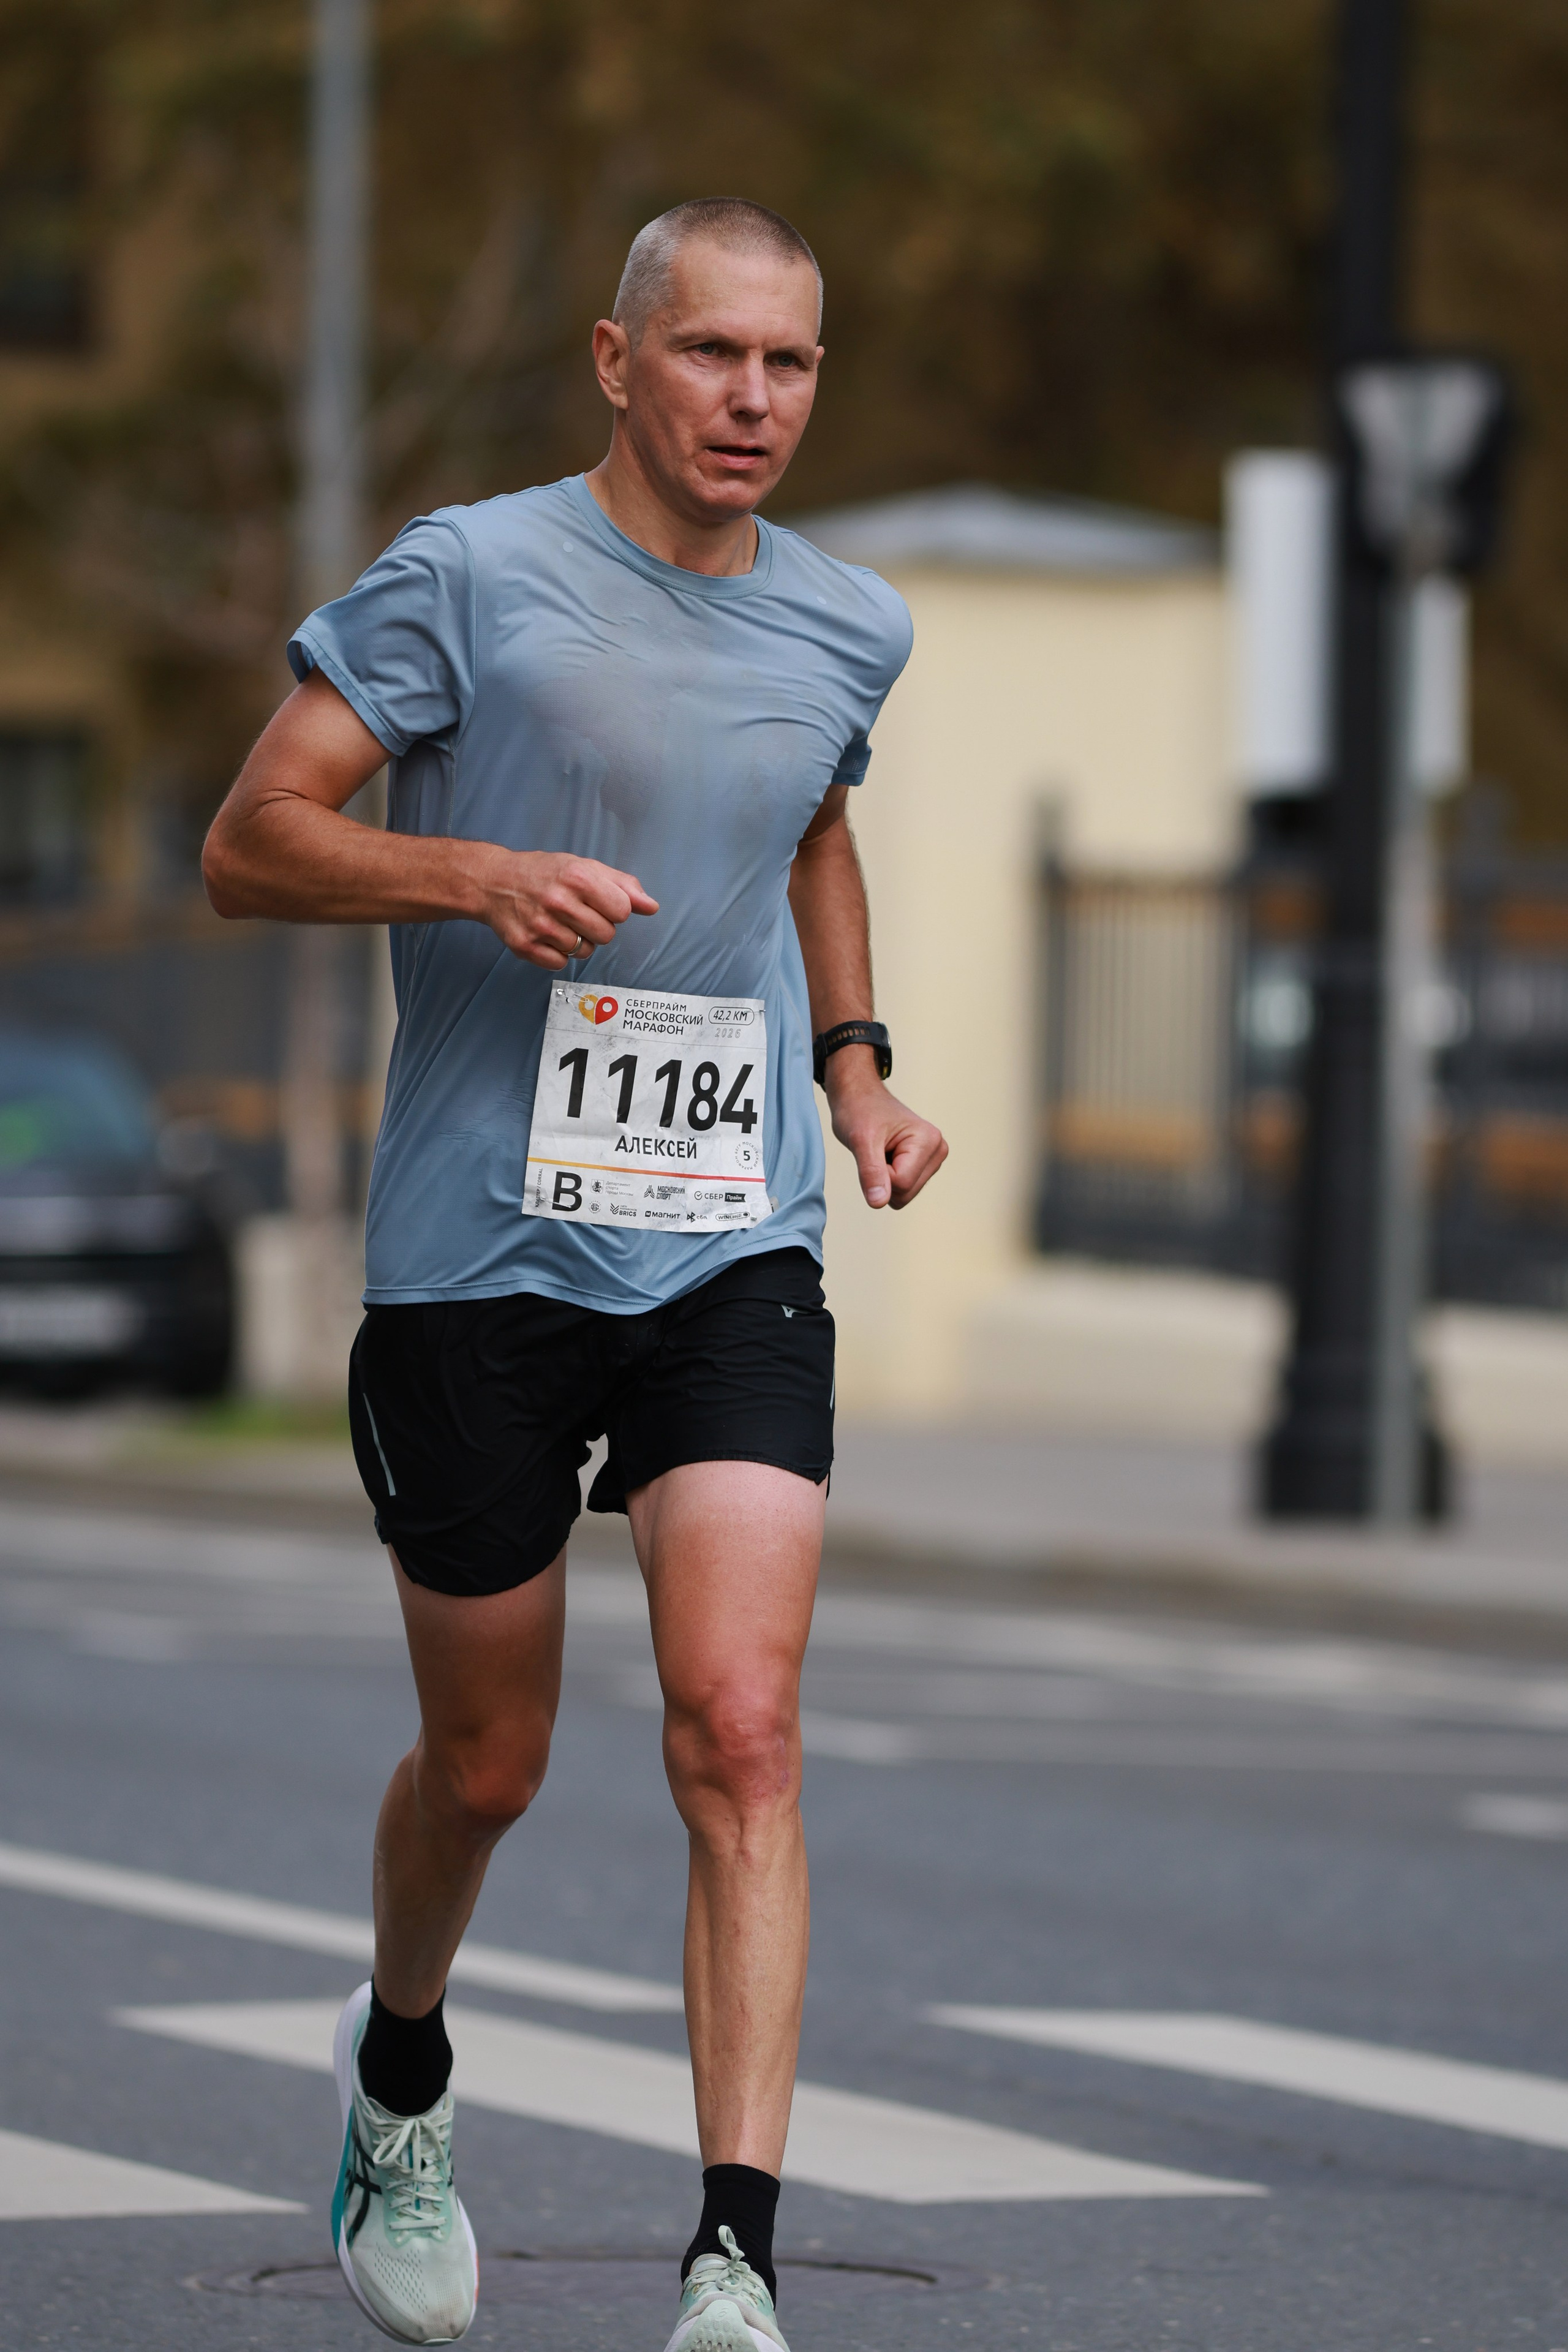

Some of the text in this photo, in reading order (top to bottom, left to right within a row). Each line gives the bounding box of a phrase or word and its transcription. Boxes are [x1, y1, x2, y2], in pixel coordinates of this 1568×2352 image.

[626, 998, 687, 1012] СБЕРПРАЙМ
[624, 1008, 703, 1025] МОСКОВСКИЙ
[713, 1010, 748, 1021] 42,2 КМ
[622, 1020, 684, 1035] МАРАФОН
[714, 1027, 741, 1039] 2026
[558, 1047, 758, 1134] 11184
[614, 1135, 697, 1159] АЛЕКСЕЙ
[743, 1150, 751, 1161] 5
[656, 1192, 672, 1200] СПОРТ
[657, 1185, 685, 1194] МОСКОВСКИЙ
